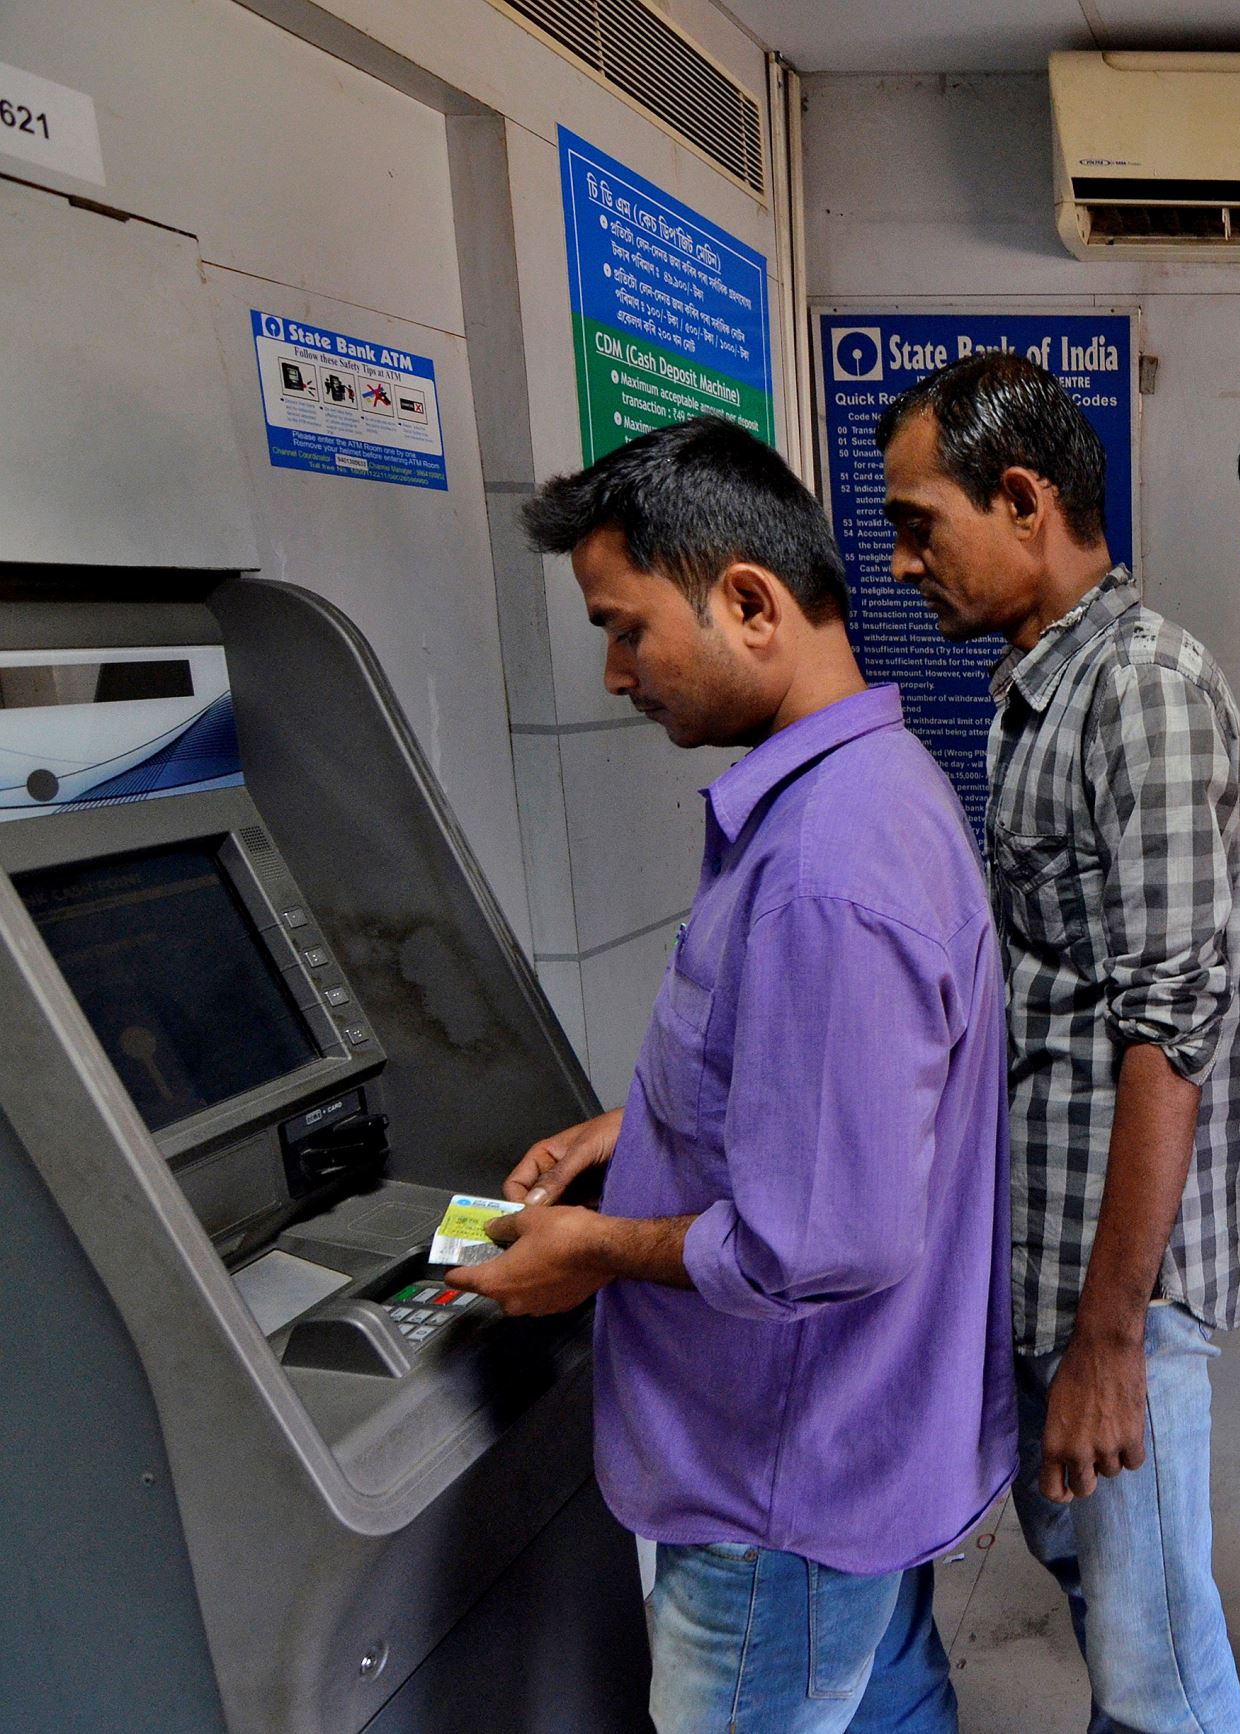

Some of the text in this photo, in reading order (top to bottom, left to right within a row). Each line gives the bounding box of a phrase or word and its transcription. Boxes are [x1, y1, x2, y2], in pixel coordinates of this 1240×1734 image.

[0, 99, 49, 139] 621
[289, 324, 413, 371] State Bank ATM
[889, 334, 1119, 371] State of India
[294, 346, 402, 381] Follow these Safety Tips at ATM
[595, 332, 741, 406] CDM (Cash Deposit Machine)
[620, 371, 659, 396] Maximum
[660, 388, 699, 410] acceptable
[737, 413, 759, 432] deposit
[621, 391, 667, 417] transaction
[835, 393, 875, 407] Quick
[1071, 394, 1118, 407] Codes
[848, 412, 870, 421] Code
[837, 426, 848, 434] 00
[292, 430, 316, 442] Please
[348, 439, 362, 449] ATM
[293, 438, 322, 450] Remove
[838, 438, 848, 446] 01
[839, 449, 882, 458] 50 Unauth
[854, 461, 866, 469] for
[853, 472, 873, 481] Card
[841, 485, 851, 493] 52
[842, 519, 882, 527] 53 Invalid
[843, 529, 891, 537] 54 Account
[859, 564, 880, 572] Cash
[860, 575, 892, 583] activate
[860, 587, 895, 595] Ineligible
[862, 610, 908, 618] Transaction
[862, 622, 907, 630] Insufficient
[863, 645, 908, 654] Insufficient
[909, 646, 935, 654] Funds
[936, 646, 951, 656] (Try
[952, 646, 964, 654] for
[864, 657, 884, 665] have
[885, 657, 923, 665] sufficient
[924, 658, 947, 666] funds
[962, 658, 975, 666] the
[962, 670, 986, 680] verify
[906, 695, 937, 703] number
[912, 717, 956, 725] withdrawal
[957, 717, 973, 725] limit
[945, 728, 967, 737] being
[944, 749, 973, 758] (Wrong
[950, 761, 965, 769] day
[965, 803, 984, 811] bank
